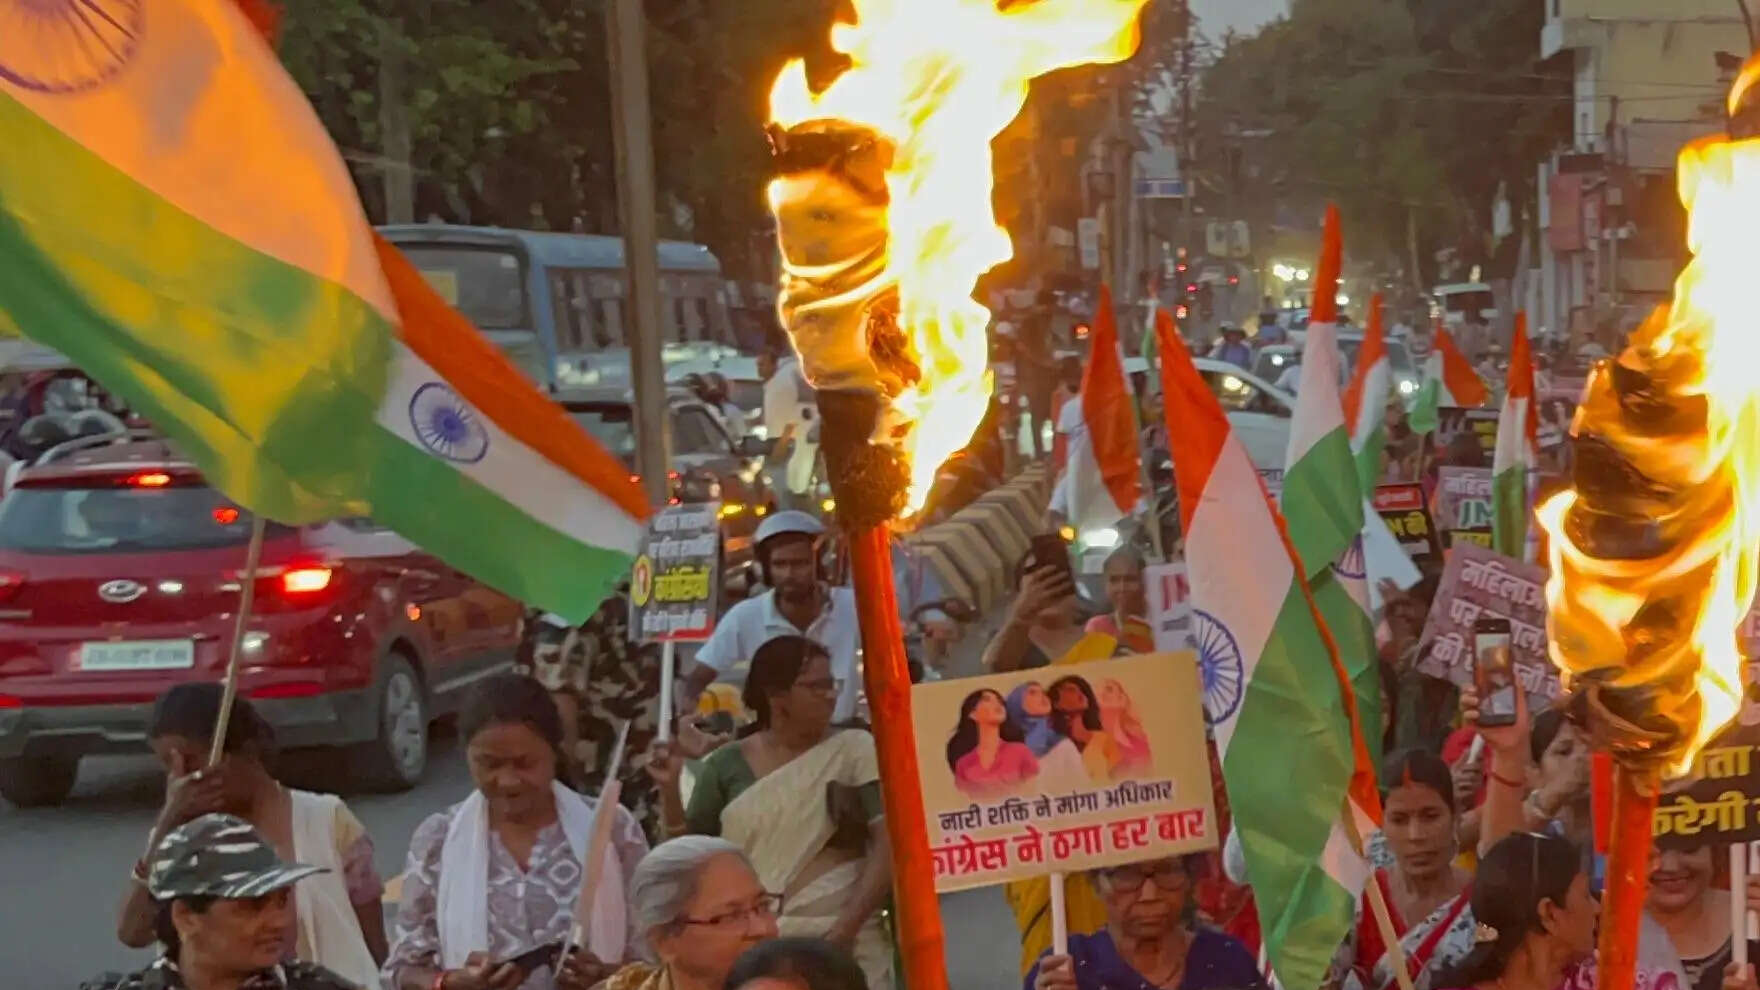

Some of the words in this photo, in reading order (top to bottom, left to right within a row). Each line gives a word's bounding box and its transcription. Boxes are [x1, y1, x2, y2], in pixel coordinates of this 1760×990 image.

[938, 804, 982, 831] नारी
[988, 798, 1029, 825] शक्ति
[1035, 795, 1052, 817] ने
[1053, 791, 1099, 815] मांगा
[1105, 780, 1173, 808] अधिकार
[1013, 826, 1043, 863] ने
[1048, 824, 1103, 860] ठगा
[1107, 817, 1149, 850] हर
[1154, 808, 1206, 840] बार
